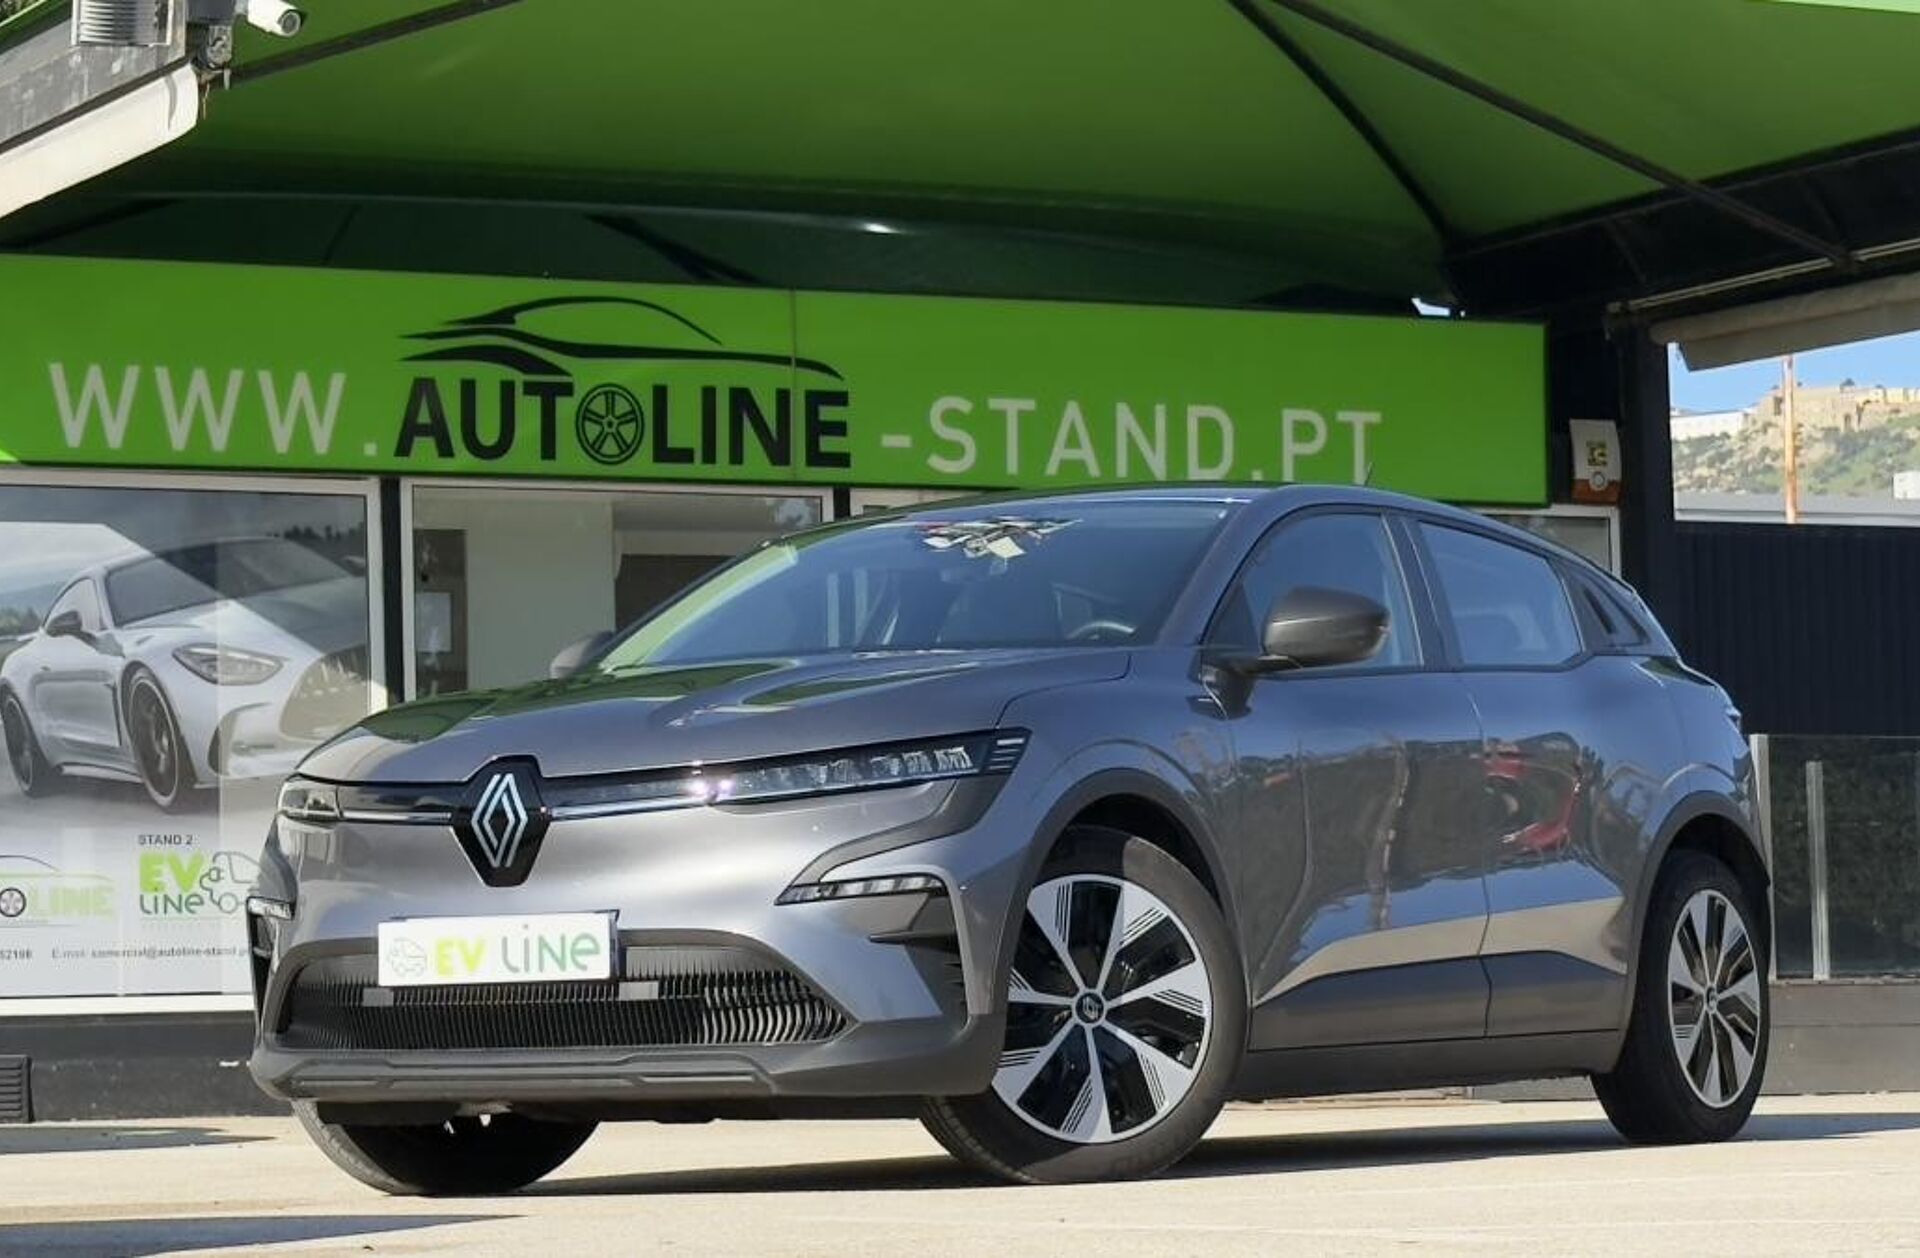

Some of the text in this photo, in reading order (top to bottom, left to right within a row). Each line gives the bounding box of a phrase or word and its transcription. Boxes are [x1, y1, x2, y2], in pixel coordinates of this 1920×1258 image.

[138, 834, 193, 845] STAND 2
[139, 852, 205, 893] EV
[437, 939, 486, 976] EV
